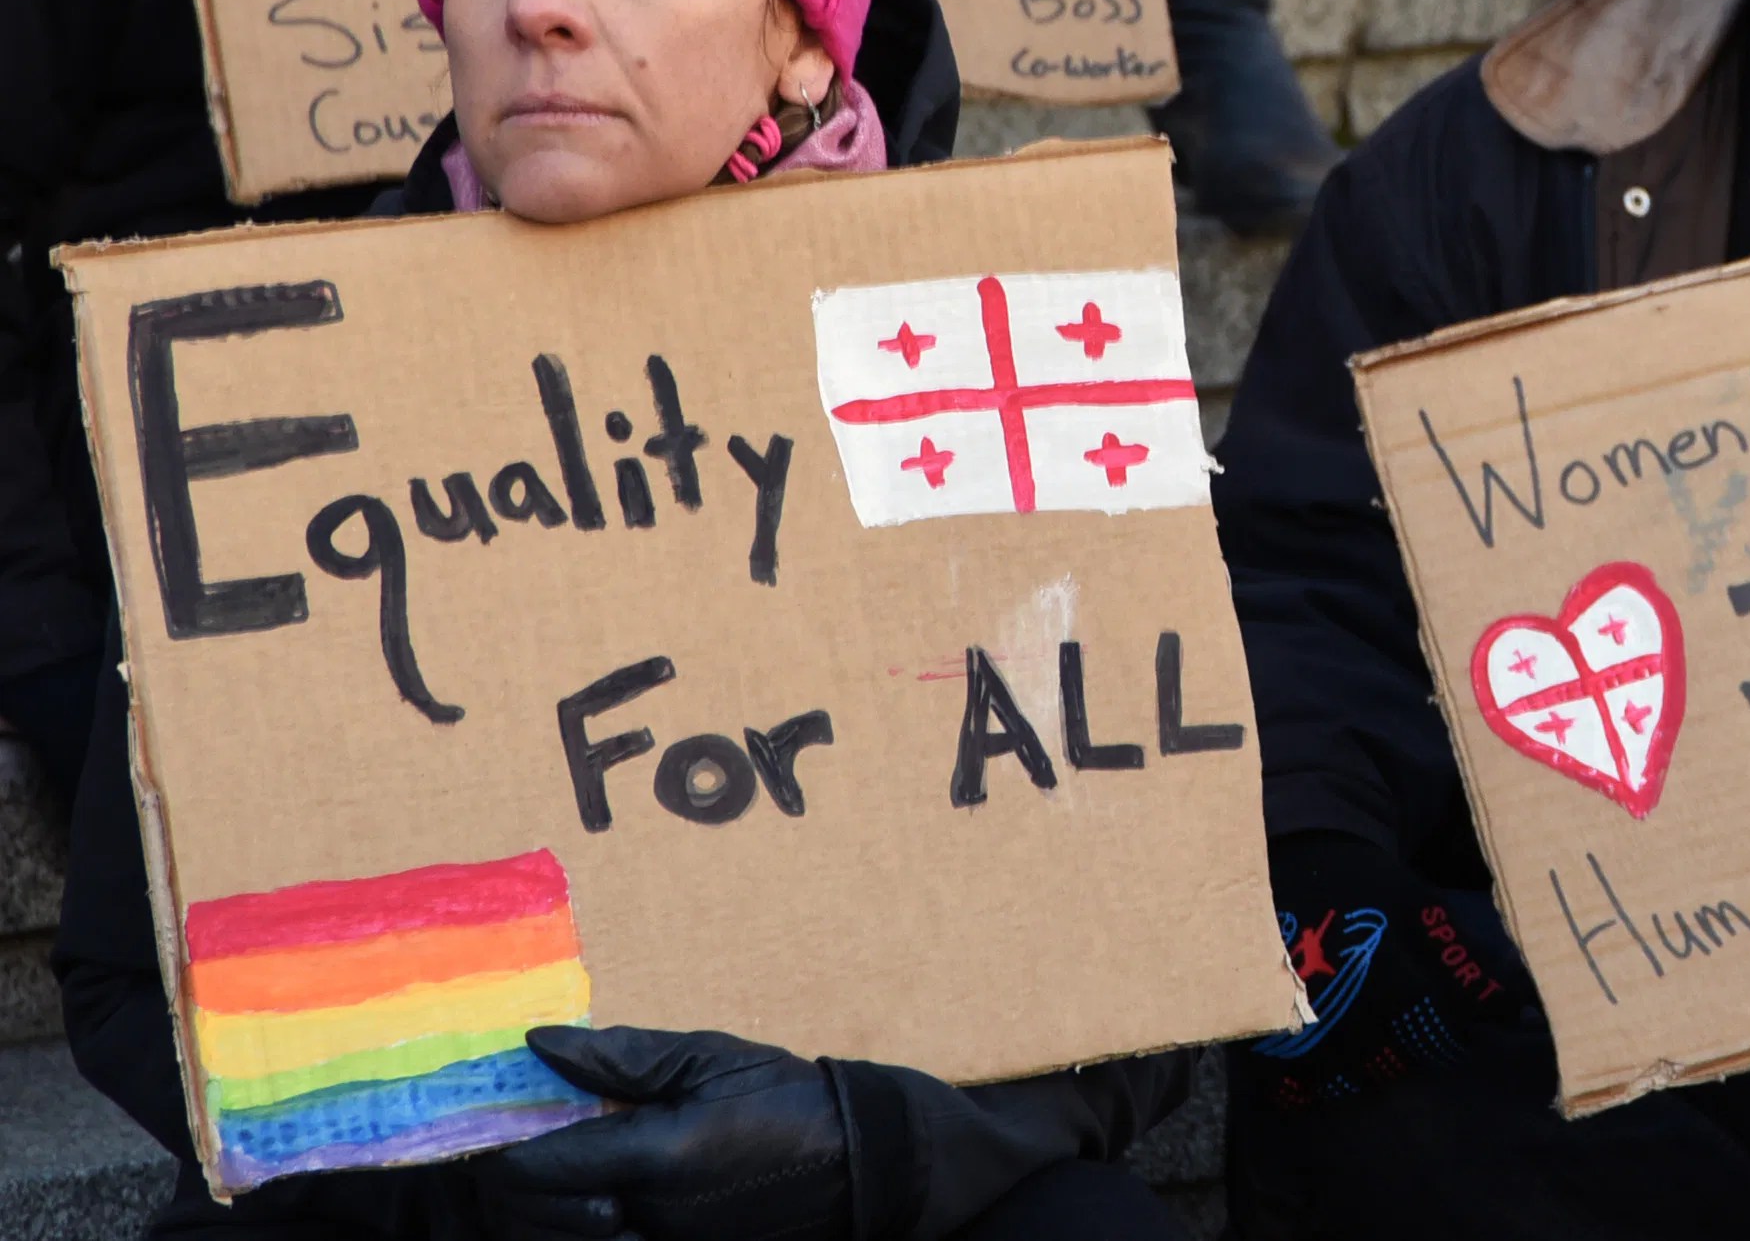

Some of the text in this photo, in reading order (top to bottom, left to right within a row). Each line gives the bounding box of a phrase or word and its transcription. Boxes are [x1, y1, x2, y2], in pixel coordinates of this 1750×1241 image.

[127, 279, 794, 725] Equality
[558, 629, 1247, 834] For ALL
[1421, 905, 1504, 1002] SPORT
